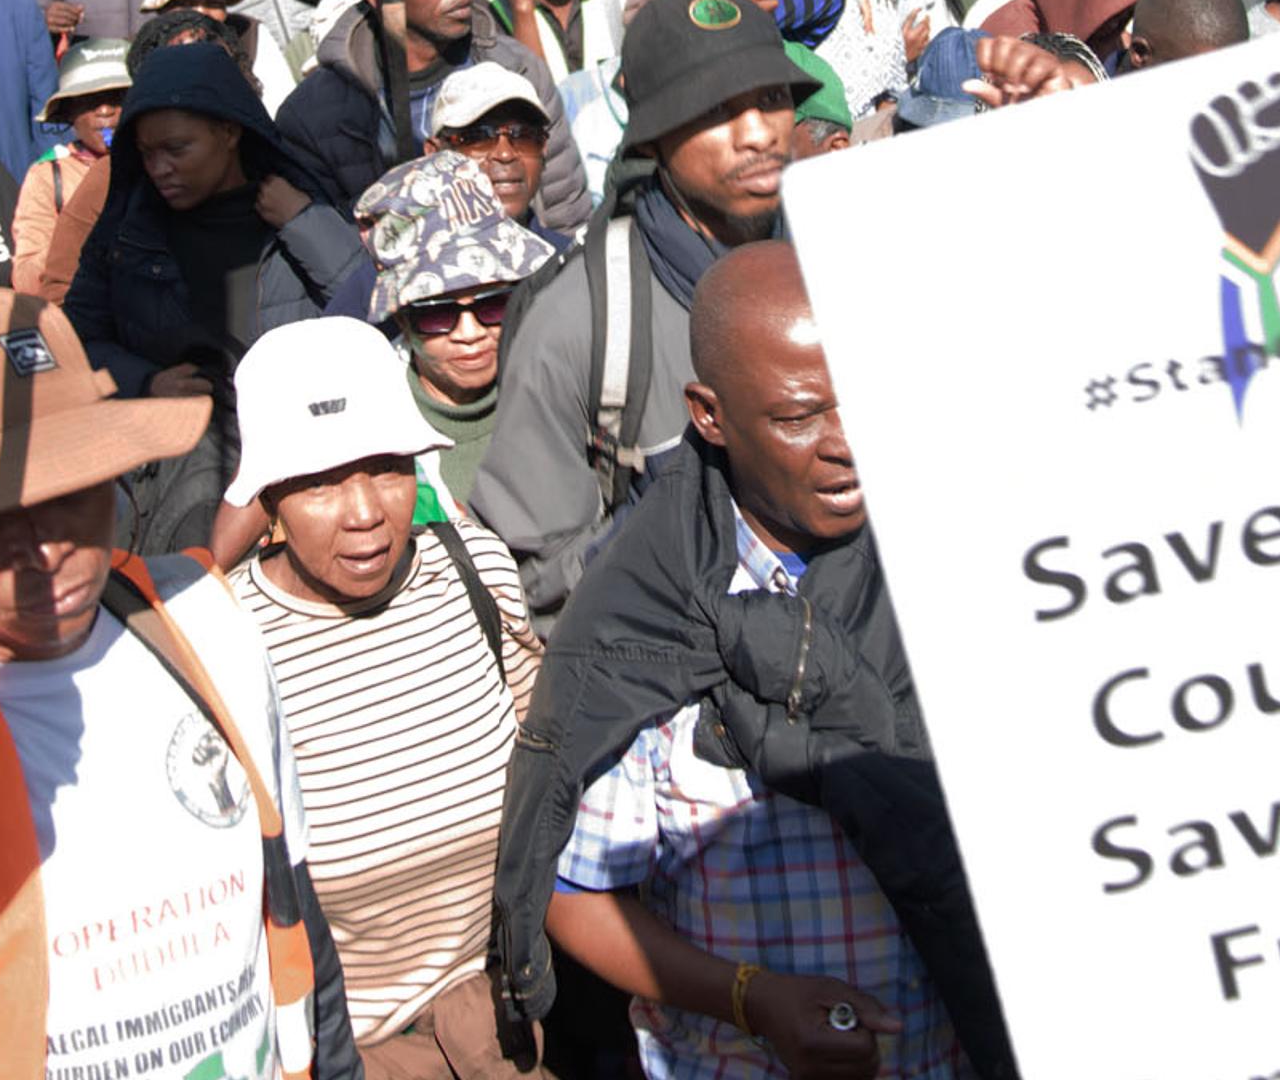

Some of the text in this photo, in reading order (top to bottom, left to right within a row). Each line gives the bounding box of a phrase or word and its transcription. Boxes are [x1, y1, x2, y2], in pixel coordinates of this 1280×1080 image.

[52, 869, 245, 957] OPERATION
[116, 980, 236, 1041] IMMIGRANTS
[135, 1048, 163, 1075] ON
[168, 1030, 206, 1065] OUR
